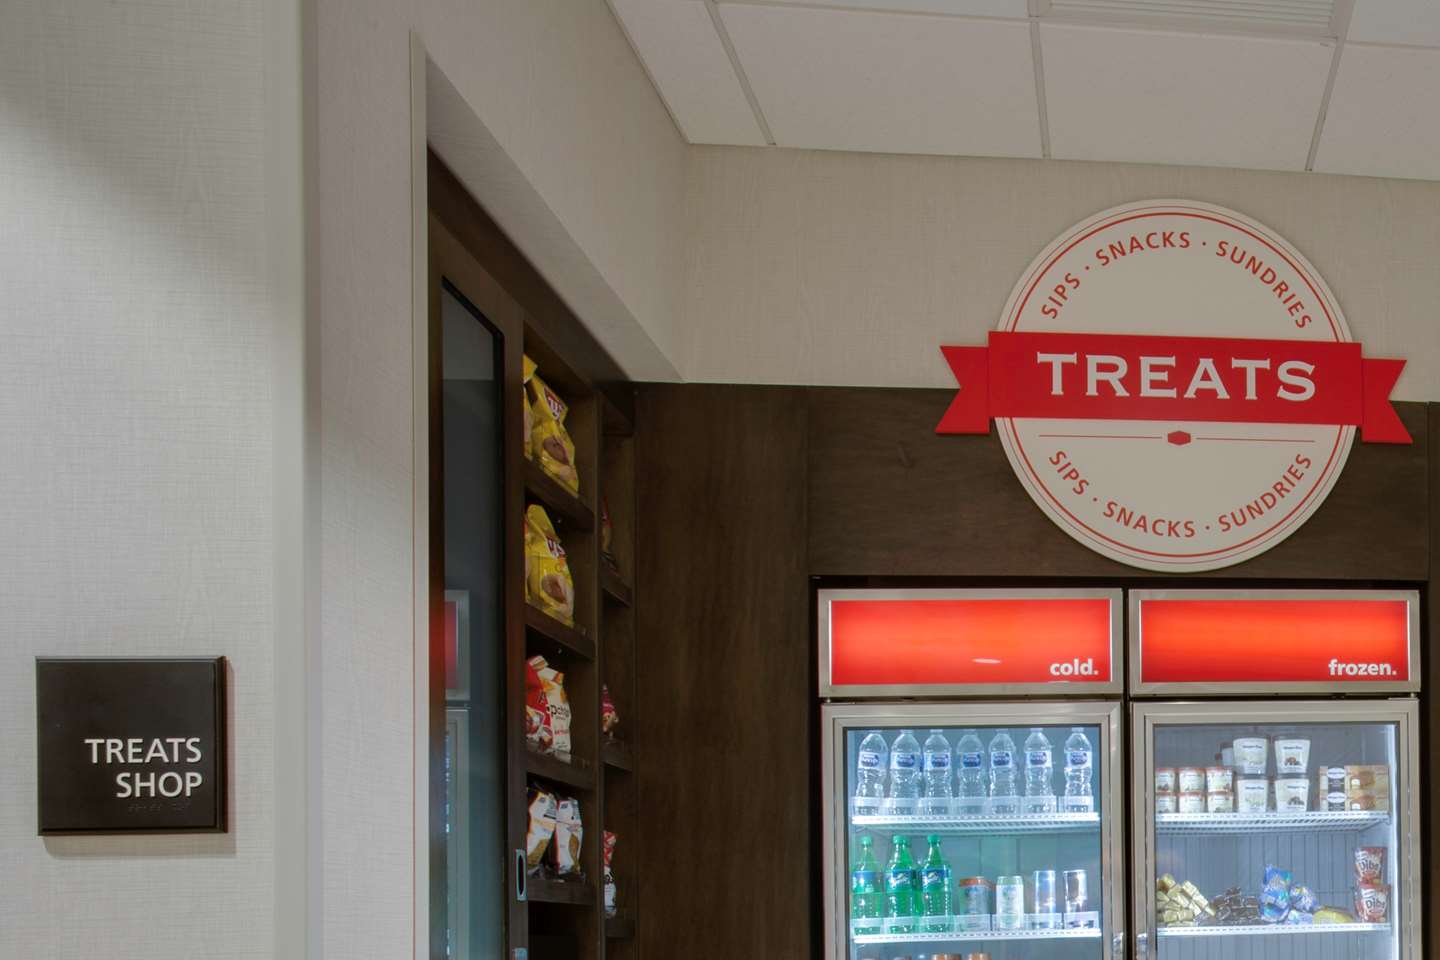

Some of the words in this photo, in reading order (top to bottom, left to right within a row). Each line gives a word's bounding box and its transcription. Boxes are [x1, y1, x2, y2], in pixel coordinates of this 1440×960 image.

[1040, 272, 1082, 320] SIPS
[1095, 231, 1192, 267] SNACKS
[1215, 240, 1313, 330] SUNDRIES
[1036, 351, 1317, 401] TREATS
[1048, 450, 1087, 496] SIPS
[1102, 500, 1195, 538] SNACKS
[1217, 453, 1313, 533] SUNDRIES
[1049, 658, 1099, 676] cold.
[1328, 658, 1398, 676] frozen.
[84, 737, 203, 764] TREATS
[116, 771, 203, 798] SHOP
